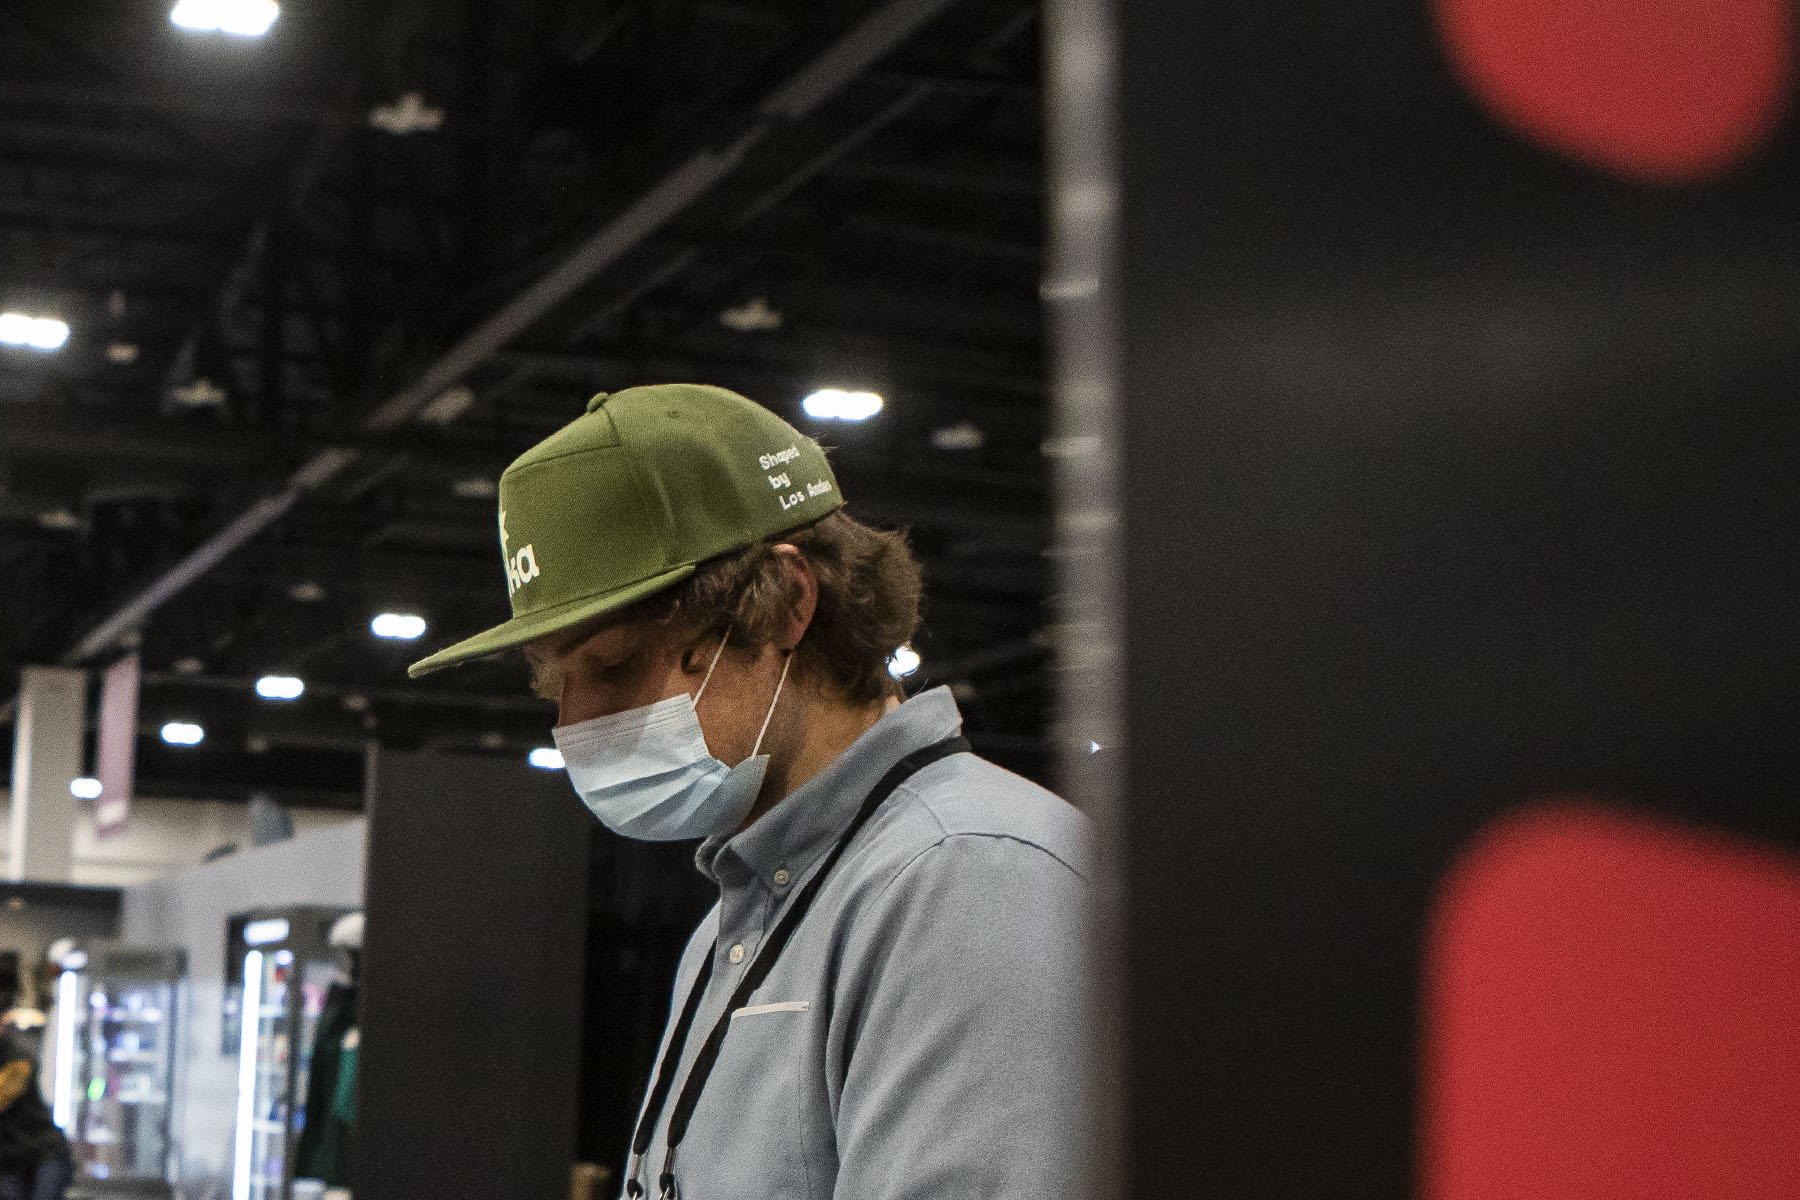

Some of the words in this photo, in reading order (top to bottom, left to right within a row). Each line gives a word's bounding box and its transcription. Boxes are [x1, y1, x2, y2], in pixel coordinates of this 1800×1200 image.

[759, 444, 800, 470] Shaped
[768, 472, 791, 489] by
[778, 491, 805, 510] Los
